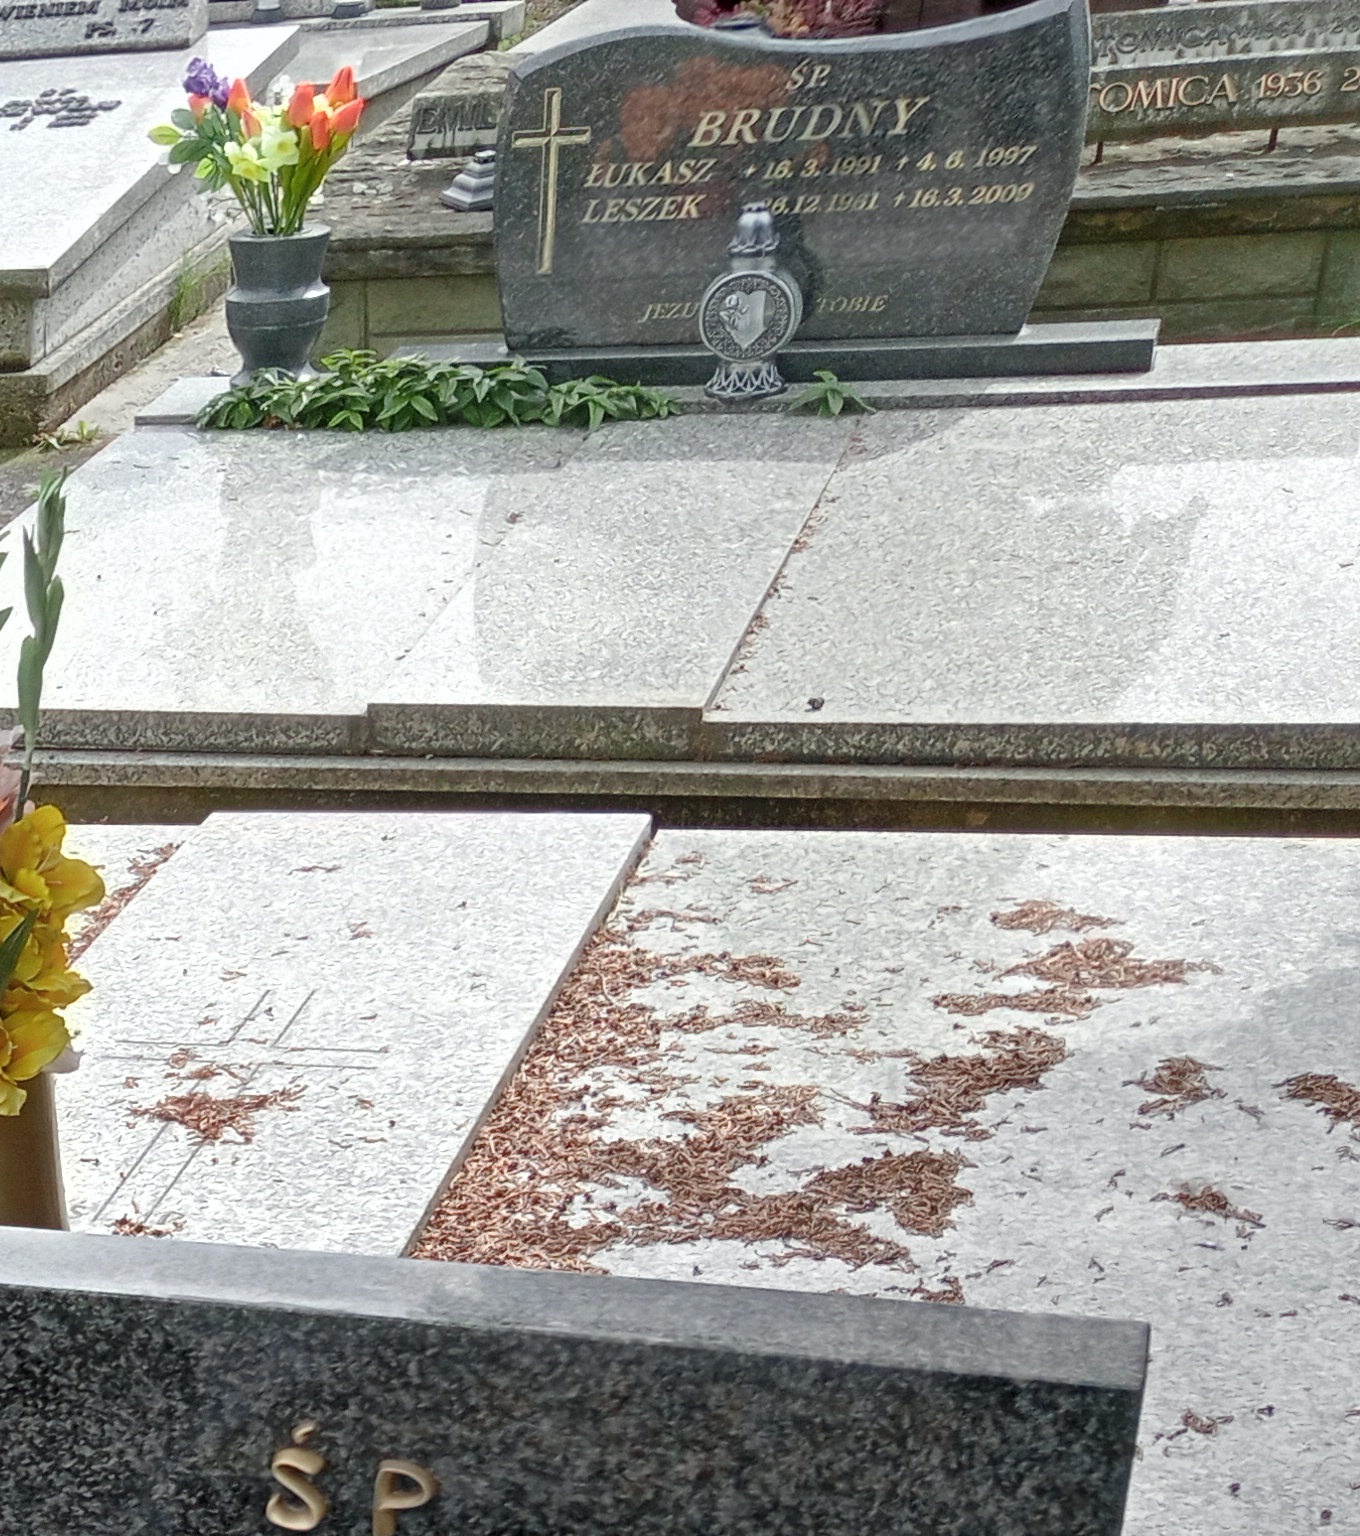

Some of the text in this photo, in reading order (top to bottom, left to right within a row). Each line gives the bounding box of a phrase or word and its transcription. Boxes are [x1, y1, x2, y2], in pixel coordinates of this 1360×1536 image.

[1090, 73, 1238, 113] OMICA
[1257, 69, 1323, 99] 1936
[687, 96, 931, 147] BRUDNY
[583, 158, 718, 188] ŁUKASZ
[827, 154, 883, 175] 1991
[972, 145, 1038, 169] 1997
[581, 194, 707, 224] LESZEK
[637, 295, 889, 324] JEZU TOBIE
[266, 1422, 328, 1532] Ś
